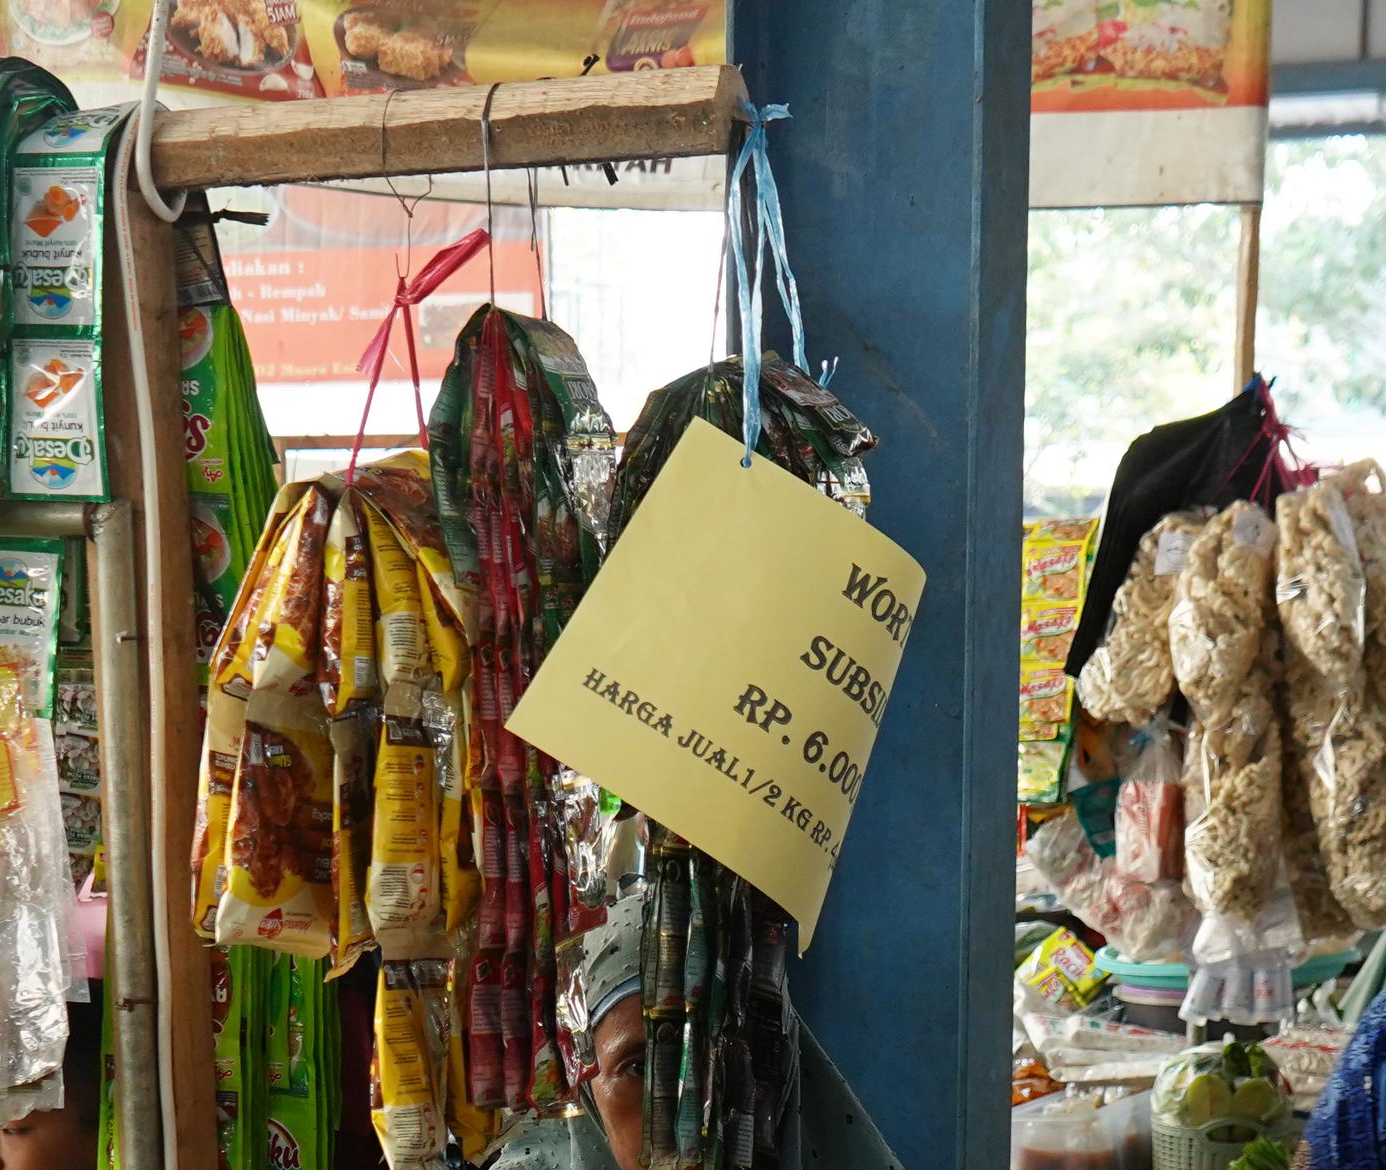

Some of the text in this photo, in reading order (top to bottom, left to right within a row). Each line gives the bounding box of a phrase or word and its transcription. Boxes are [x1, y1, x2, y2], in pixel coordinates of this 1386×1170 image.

[14, 264, 92, 298] Desaku
[49, 421, 84, 434] kunyit
[15, 433, 95, 466] Desaku
[12, 611, 46, 627] bubuk
[581, 666, 674, 740] HARGA
[780, 795, 814, 833] KG
